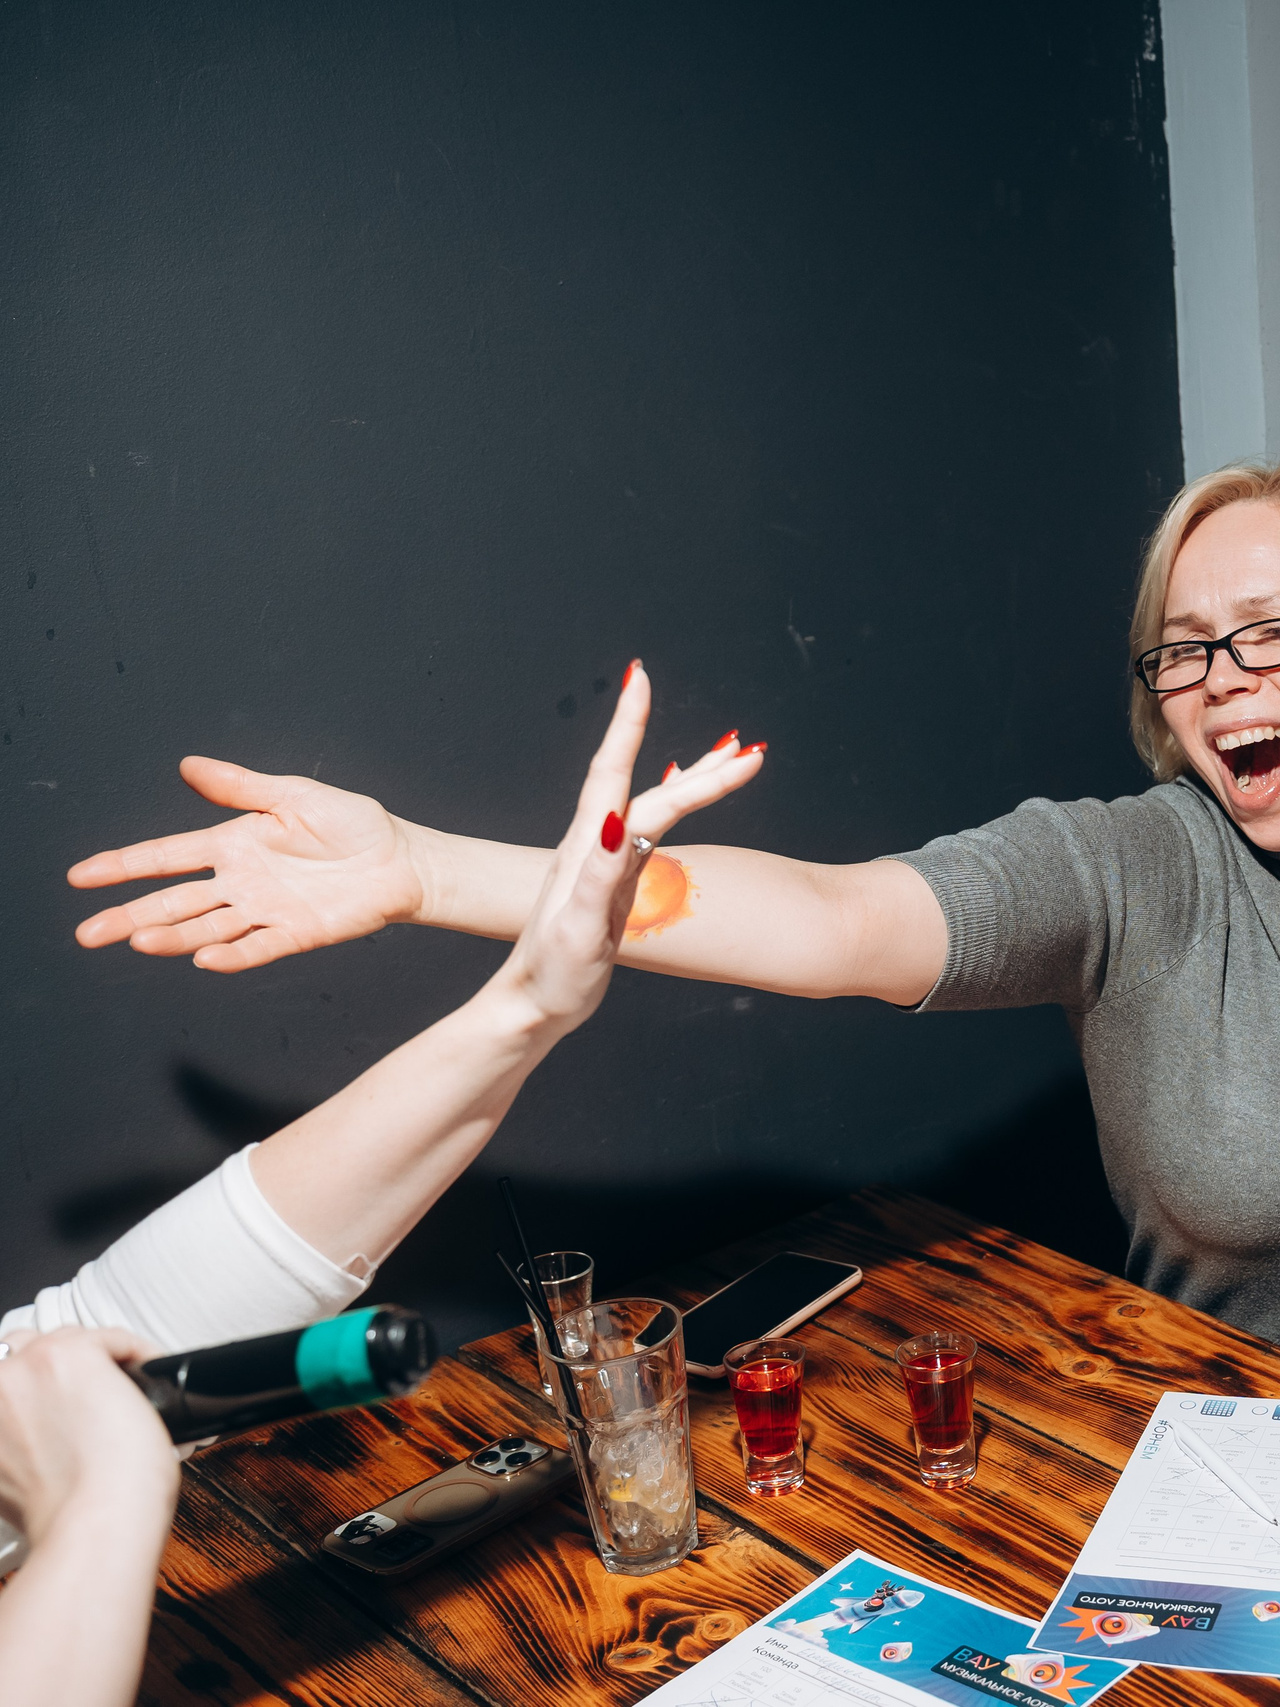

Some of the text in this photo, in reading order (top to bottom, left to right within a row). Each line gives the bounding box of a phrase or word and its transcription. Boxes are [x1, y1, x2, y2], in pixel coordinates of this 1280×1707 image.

[1079, 1595, 1216, 1615] МУЗЫКАЛЬНОЕ ЛОТО
[1161, 1614, 1211, 1630] ВАУ
[765, 1636, 789, 1650] Имя
[752, 1646, 800, 1670] Команда
[953, 1648, 1000, 1671] ВАУ
[940, 1661, 1024, 1700] МУЗЫКАЛЬНОЕ
